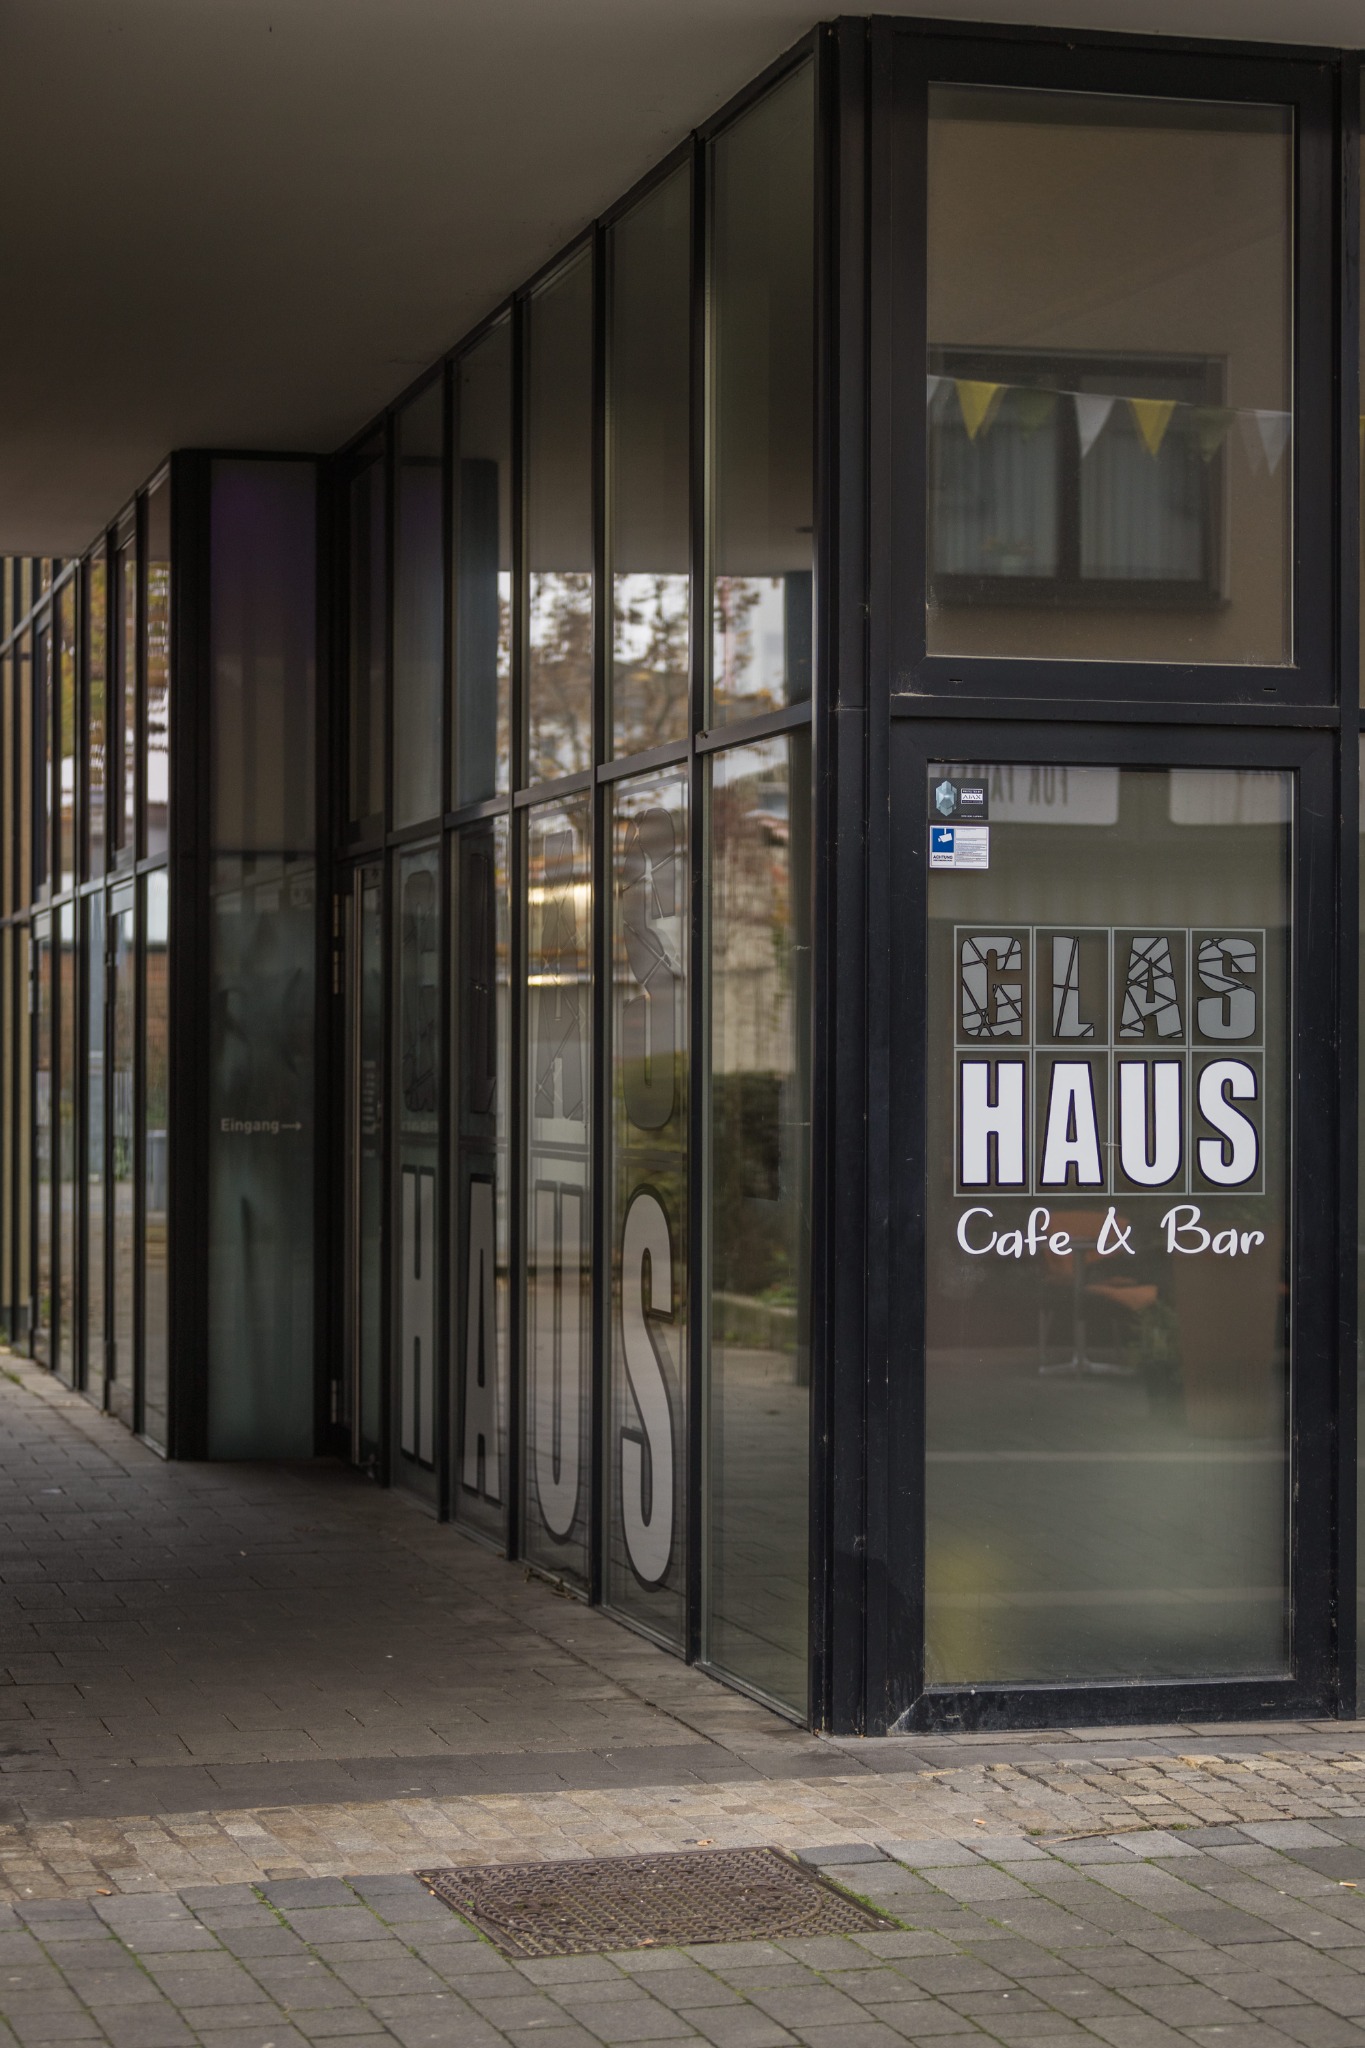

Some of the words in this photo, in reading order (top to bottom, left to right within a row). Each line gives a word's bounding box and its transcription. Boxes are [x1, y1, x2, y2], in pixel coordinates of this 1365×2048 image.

[960, 935, 1257, 1040] GLAS
[220, 1118, 280, 1134] Eingang
[960, 1058, 1259, 1187] HAUS
[957, 1207, 1073, 1258] Cafe
[1096, 1206, 1136, 1256] &
[1160, 1204, 1265, 1257] Bar
[400, 1163, 676, 1592] HAUS
